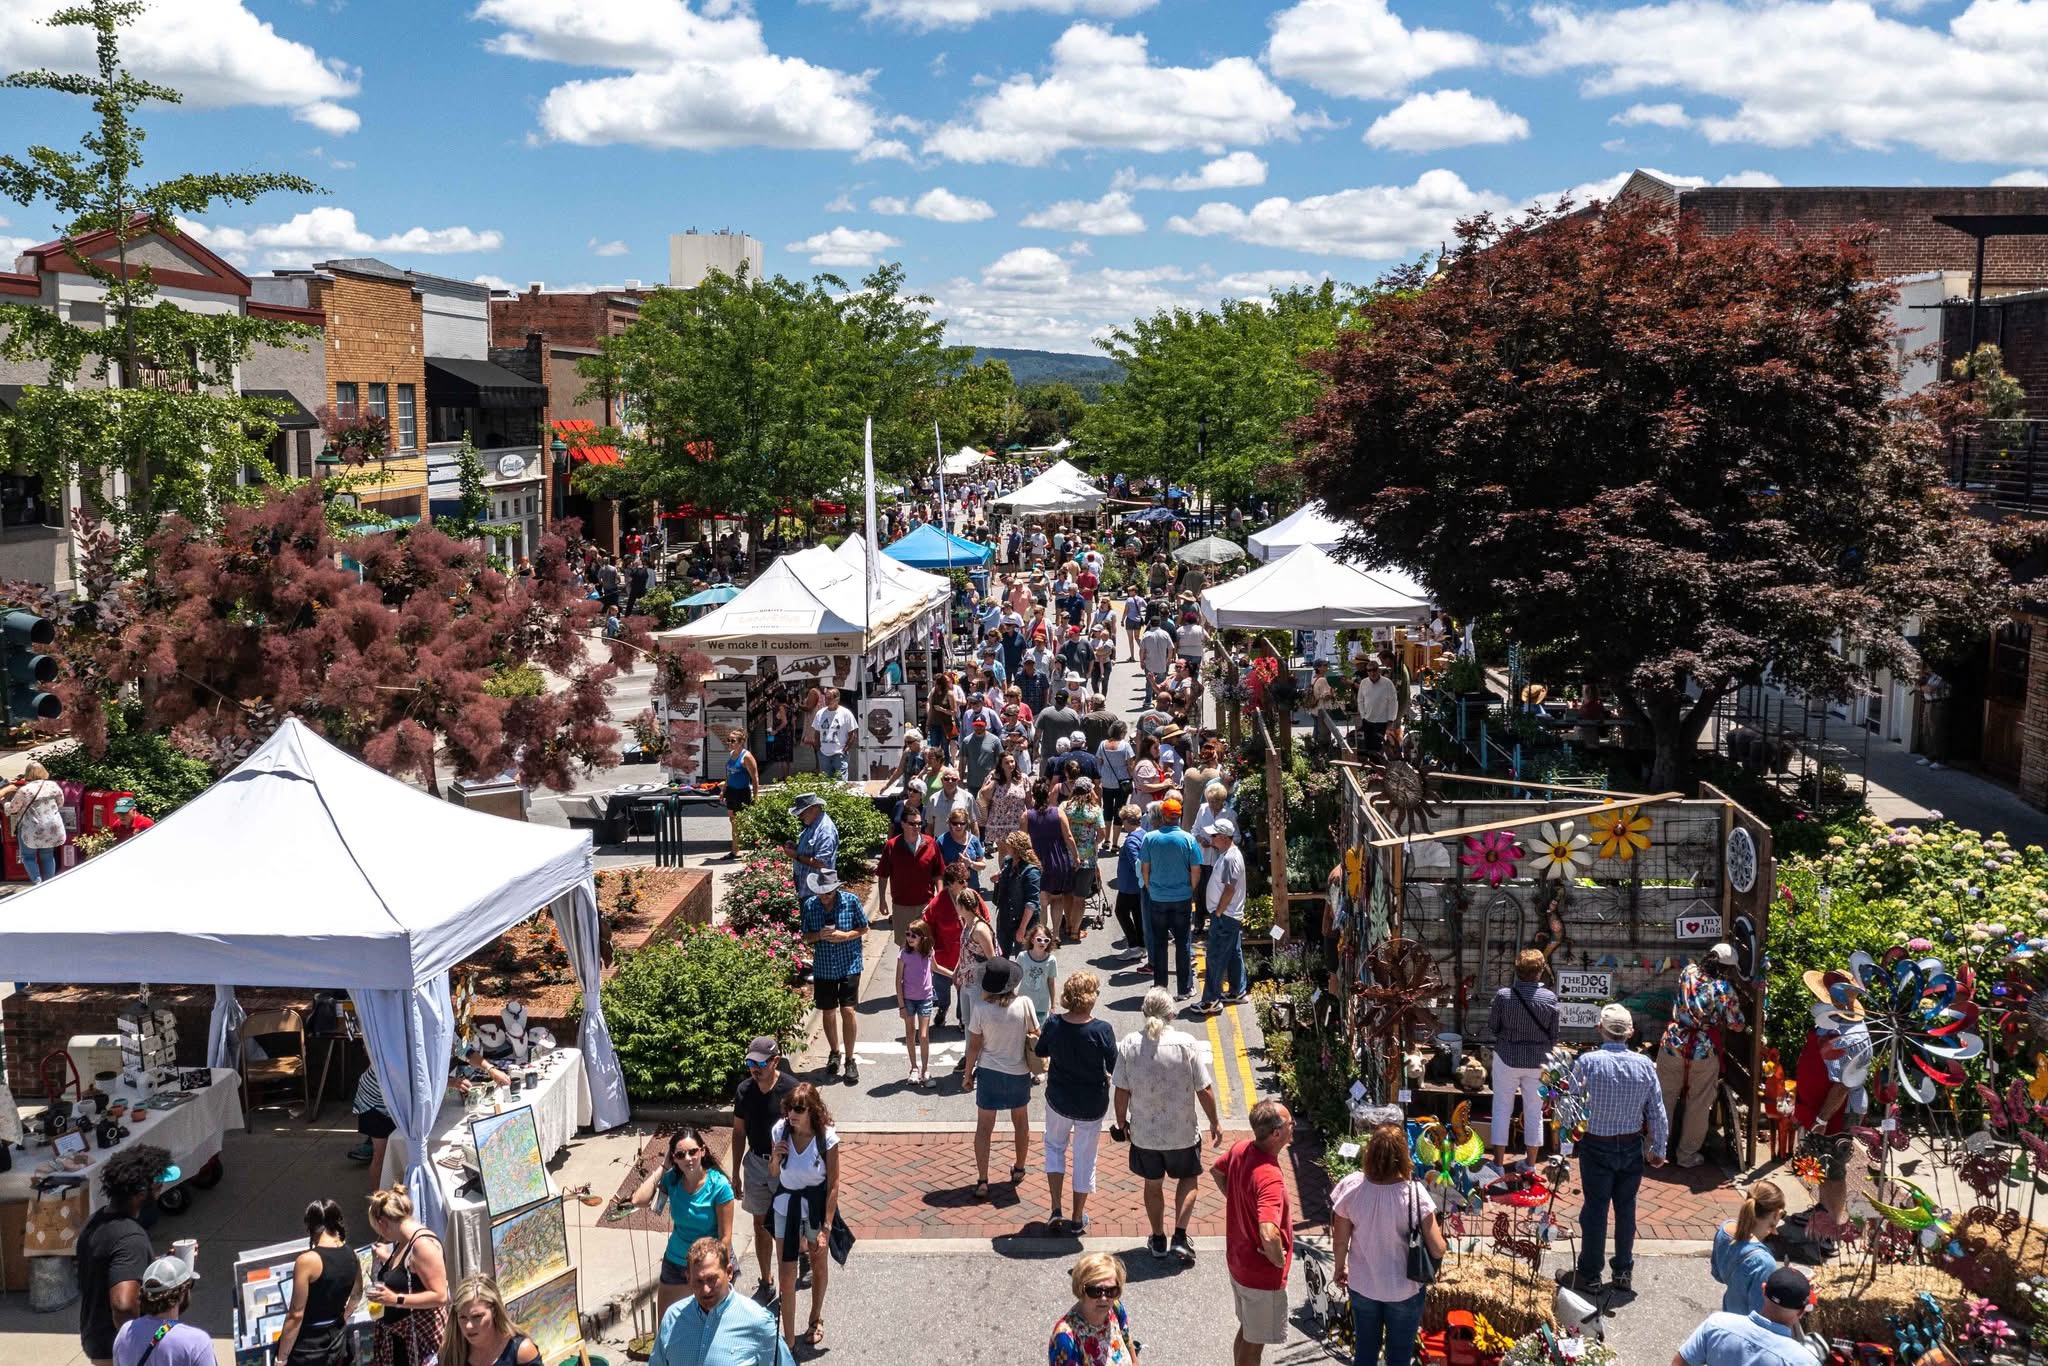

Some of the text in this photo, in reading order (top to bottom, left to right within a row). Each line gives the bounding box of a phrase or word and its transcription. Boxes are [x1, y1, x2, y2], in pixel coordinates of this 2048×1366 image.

[707, 640, 812, 650] We make it custom.
[1678, 918, 1720, 937] I my
[1701, 925, 1720, 934] Dog
[1581, 975, 1607, 986] DOG
